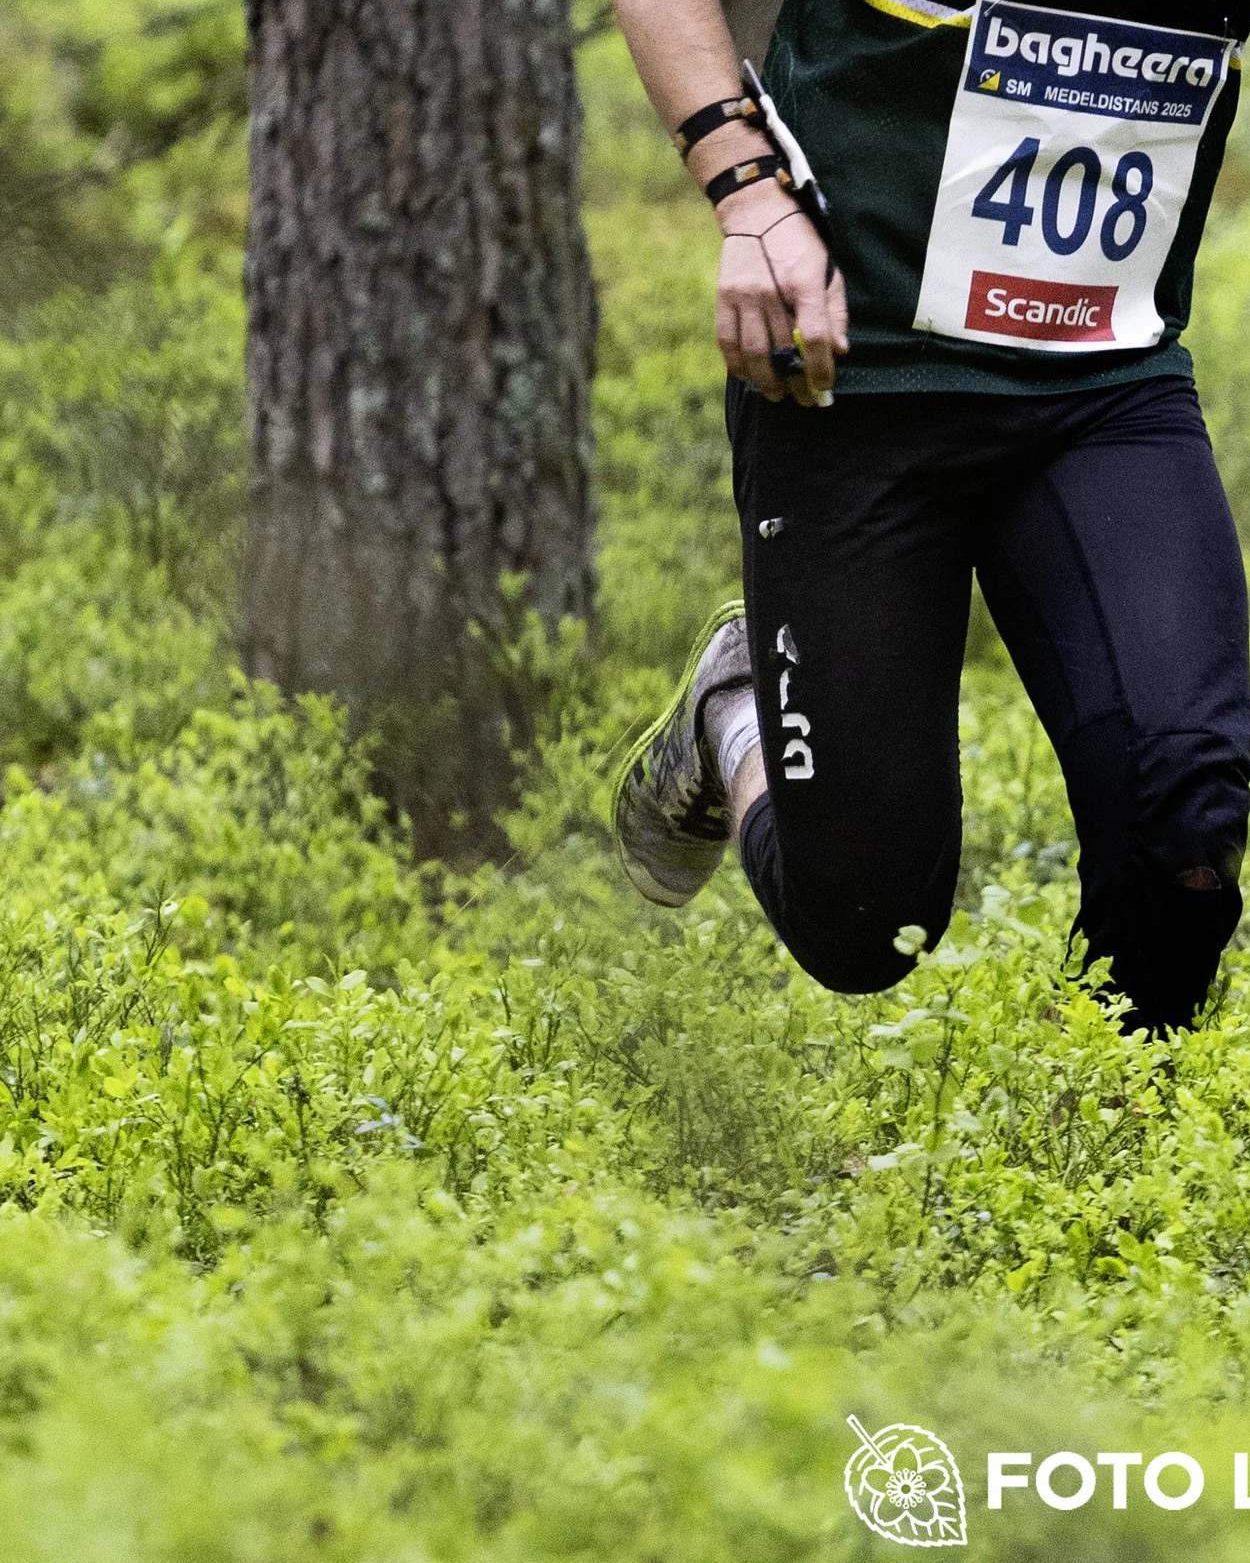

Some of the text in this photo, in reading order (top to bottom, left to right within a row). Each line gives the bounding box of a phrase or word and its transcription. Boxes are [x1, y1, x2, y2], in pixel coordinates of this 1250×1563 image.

[984, 17, 1214, 87] bagheera
[1006, 78, 1193, 118] SM MEDELDISTANS 2025
[971, 137, 1153, 262] 408
[984, 288, 1101, 327] Scandic
